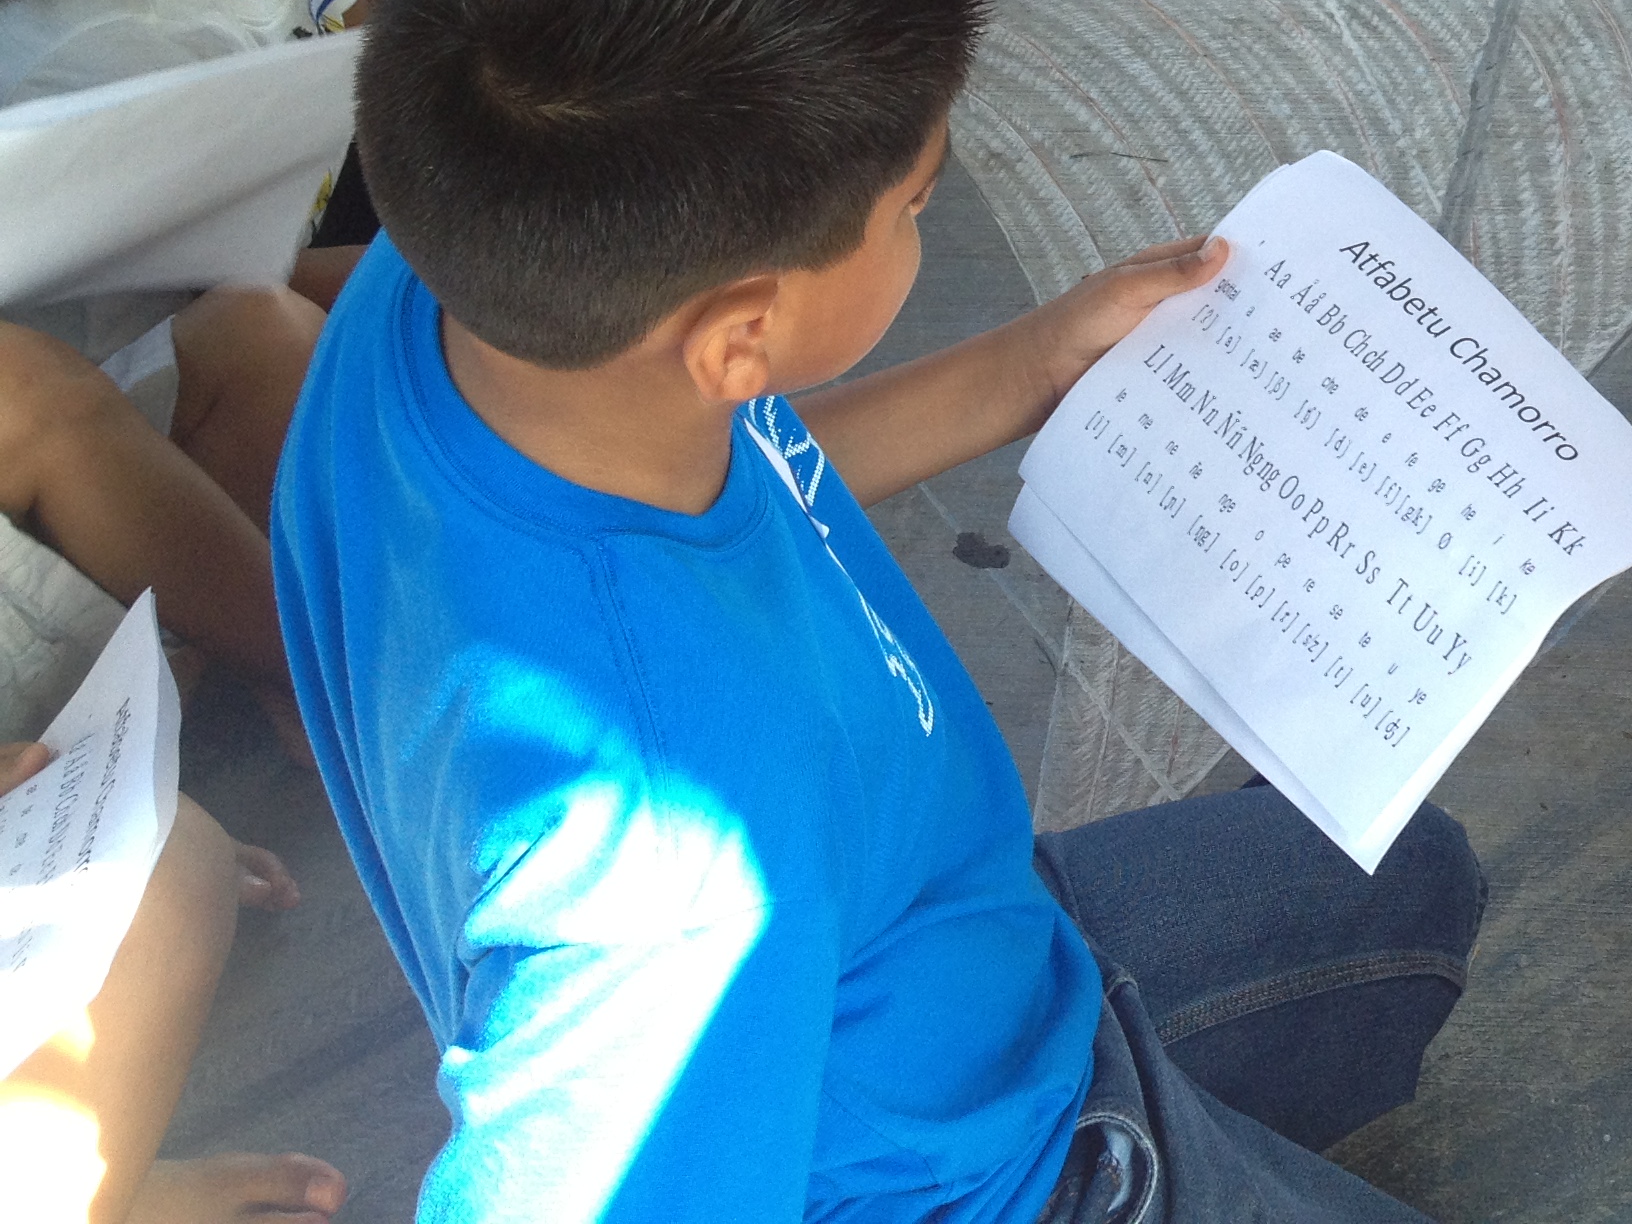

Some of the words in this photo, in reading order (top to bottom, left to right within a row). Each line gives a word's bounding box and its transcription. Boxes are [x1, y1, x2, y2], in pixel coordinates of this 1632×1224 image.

[1245, 306, 1256, 317] a
[1321, 376, 1339, 395] che
[1354, 406, 1369, 421] de
[1382, 432, 1392, 443] e
[1427, 478, 1446, 493] ge
[1460, 503, 1477, 521] he
[1519, 558, 1536, 575] ke
[1263, 259, 1292, 289] Aa
[1290, 279, 1327, 314] Åå
[1316, 304, 1348, 335] Bb
[1343, 329, 1389, 373] Chch
[1379, 362, 1420, 396] Dd
[1406, 387, 1437, 418] Ee
[1433, 412, 1470, 441] Ff
[1461, 437, 1492, 473] Gg
[1487, 463, 1526, 499] Hh
[1523, 497, 1555, 522] Ii
[1548, 521, 1586, 555] Kk
[1338, 241, 1449, 338] Atfabetu
[1449, 337, 1579, 461] Chamorro
[1143, 344, 1174, 374] Ll
[1162, 362, 1196, 403] Mm
[1190, 389, 1219, 426] Nn
[1213, 410, 1248, 450] Ññ
[1237, 435, 1281, 492] Ngng
[1278, 475, 1306, 511] Oo
[1302, 498, 1330, 538] Pp
[1326, 522, 1356, 559] Rr
[1355, 550, 1381, 585] Ss
[1386, 577, 1414, 614] Tt
[1413, 602, 1443, 645] Uu
[1442, 632, 1472, 675] Yy
[1165, 440, 1179, 455] ne
[1254, 530, 1265, 541] o
[1274, 552, 1291, 568] pe
[1329, 604, 1344, 620] se
[1407, 688, 1427, 705] ye
[1219, 548, 1249, 582] [o]
[1245, 575, 1275, 608] [p]
[1324, 428, 1352, 458] [d]
[1458, 555, 1487, 586] [i]
[1486, 580, 1517, 615] [k]
